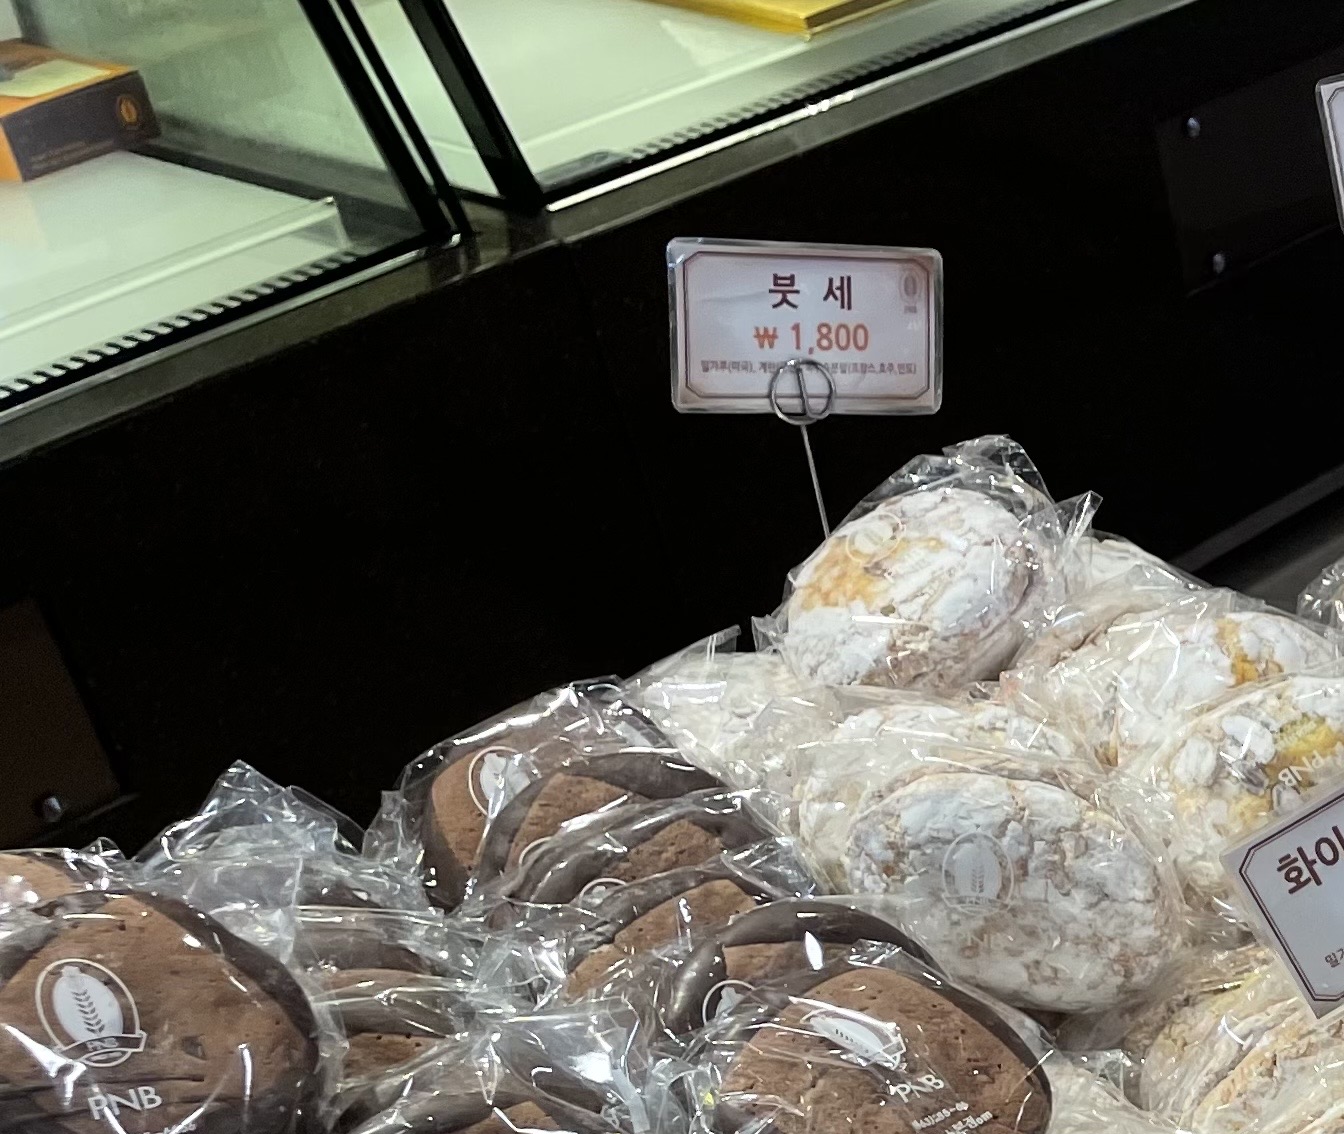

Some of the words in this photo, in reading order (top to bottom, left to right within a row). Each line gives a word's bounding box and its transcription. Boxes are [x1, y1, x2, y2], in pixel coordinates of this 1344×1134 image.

[790, 321, 869, 356] 1,800
[87, 1085, 163, 1121] PNB
[897, 1074, 945, 1104] PNB
